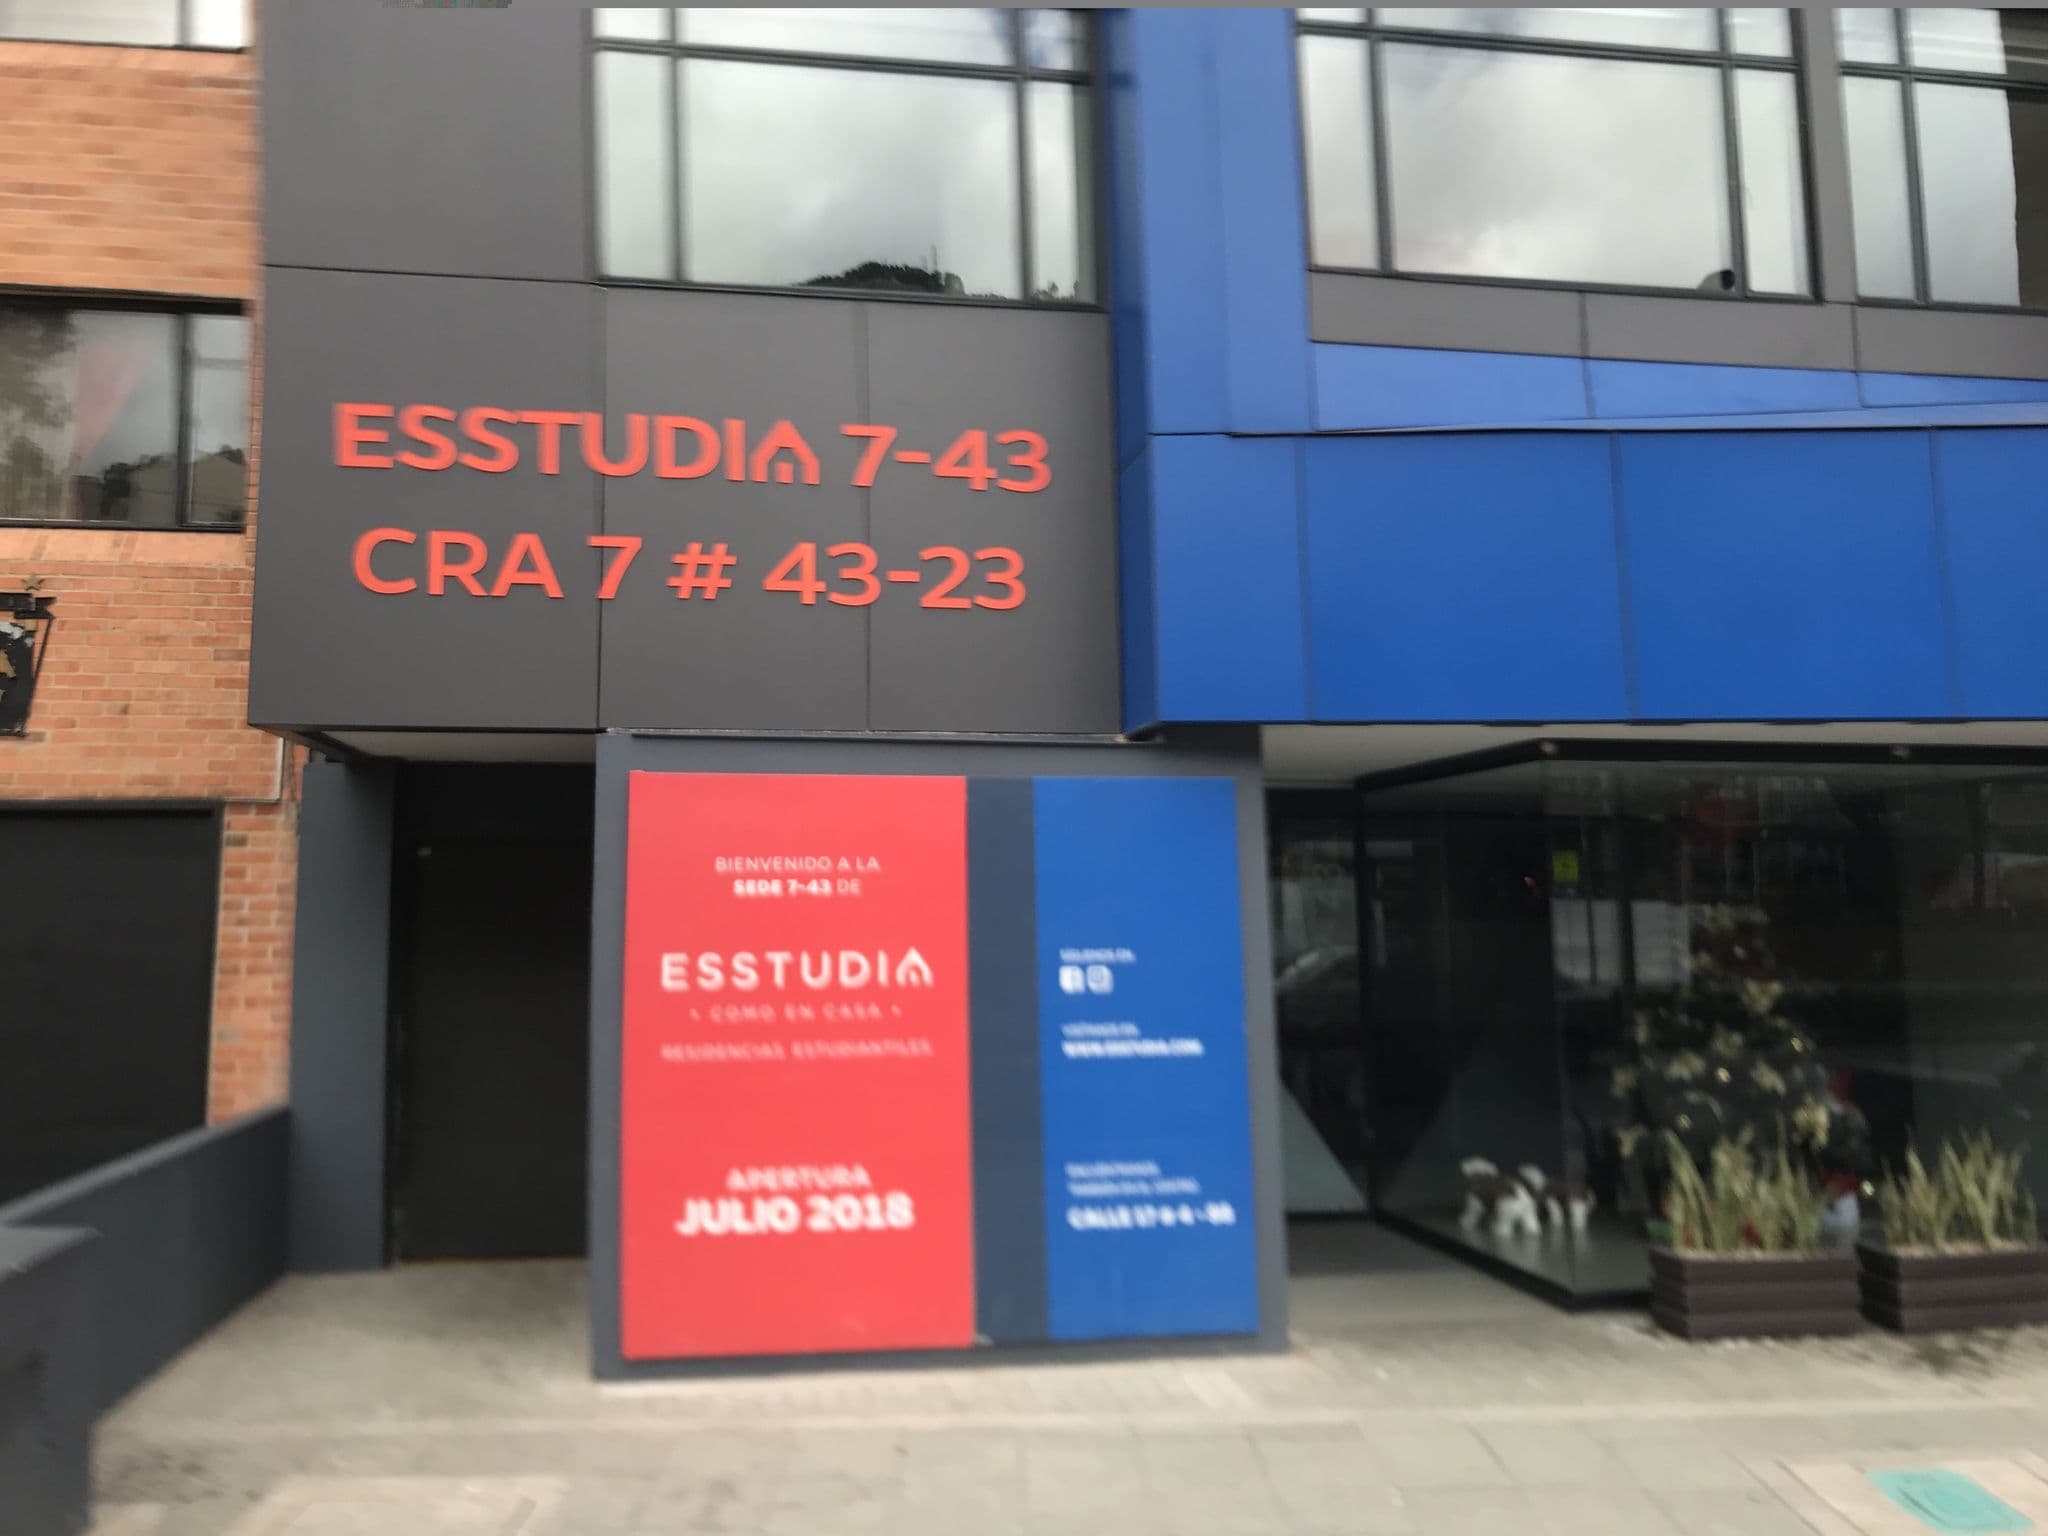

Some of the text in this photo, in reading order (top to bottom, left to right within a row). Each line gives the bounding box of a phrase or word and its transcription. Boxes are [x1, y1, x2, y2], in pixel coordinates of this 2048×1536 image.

[332, 402, 1052, 494] ESSTUDIA 7-43
[352, 526, 1027, 611] CRA 7 # 43-23
[714, 855, 881, 874] BIENVENIDO A LA
[732, 878, 862, 897] SEDE 7-43 DE
[660, 946, 933, 992] ESSTUDIA
[674, 1190, 916, 1236] JULIO 2018
